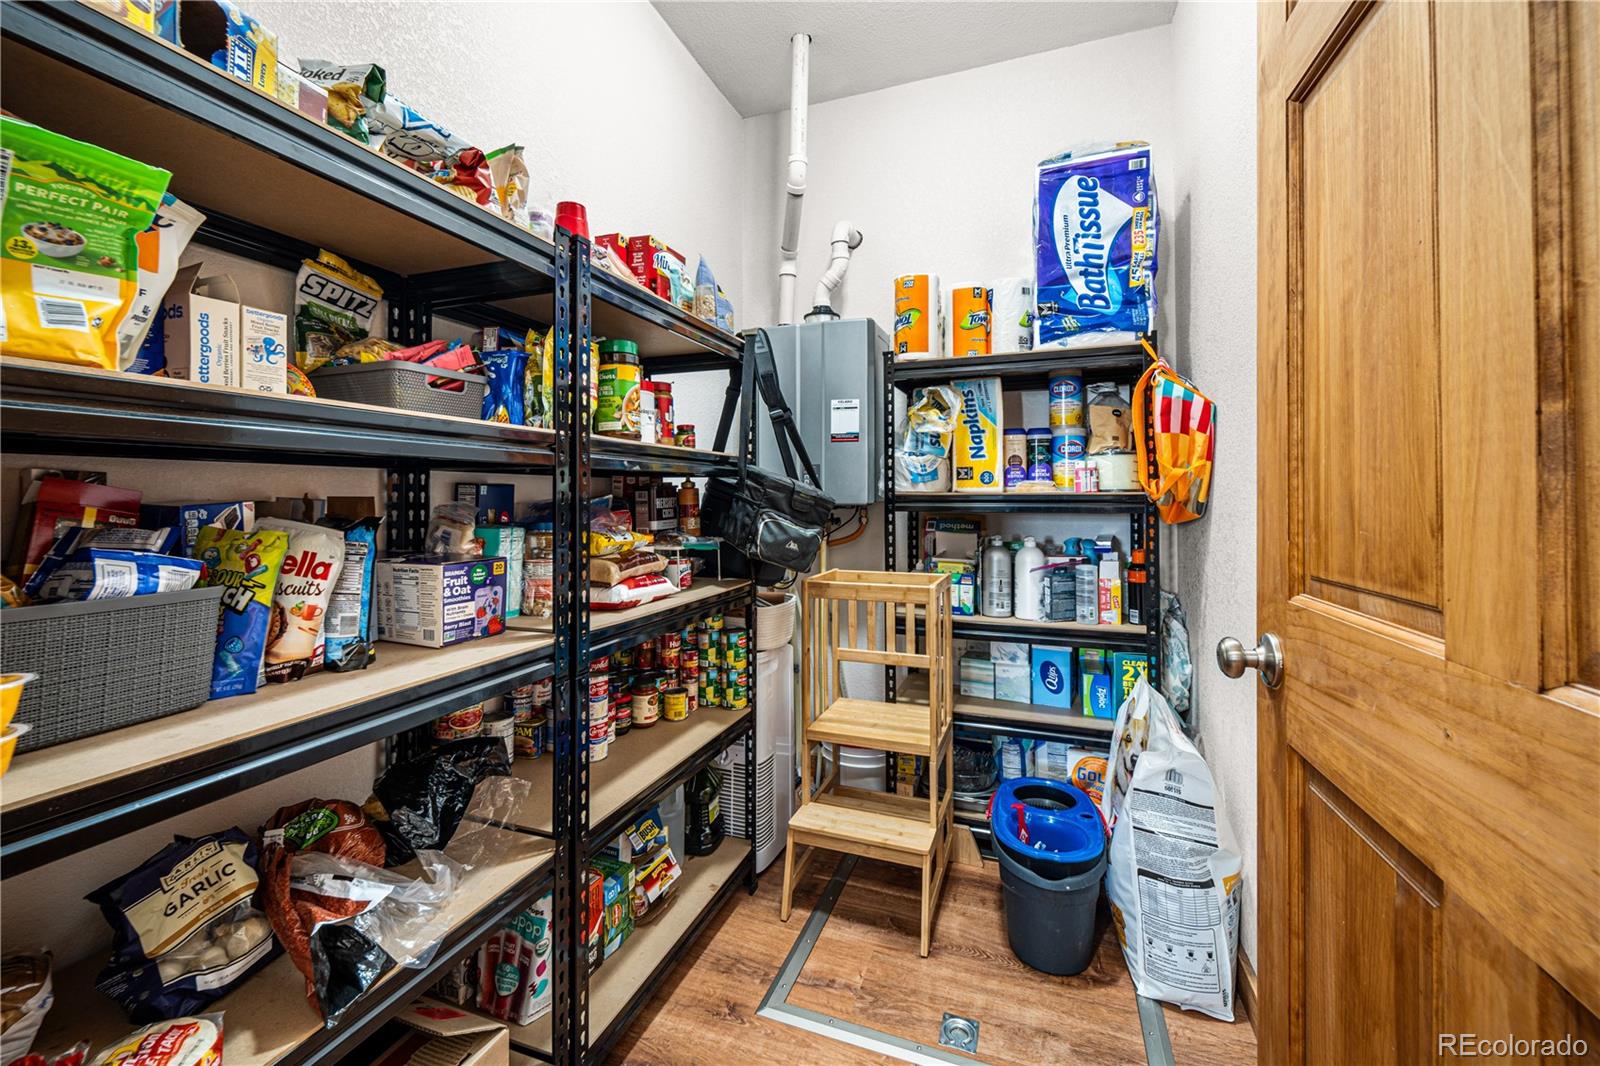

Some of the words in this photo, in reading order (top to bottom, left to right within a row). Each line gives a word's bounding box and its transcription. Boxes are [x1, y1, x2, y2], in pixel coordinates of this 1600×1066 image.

[15, 181, 89, 208] PERFECT
[92, 201, 129, 219] PAIR
[1063, 214, 1072, 252] Premium
[300, 273, 378, 319] SPITZ
[200, 312, 212, 384] ettergoods
[1053, 384, 1074, 393] CLOROX
[961, 389, 987, 459] Napkins
[1060, 445, 1082, 453] CLOROX
[939, 522, 975, 530] method
[443, 576, 469, 588] Fruit
[443, 587, 452, 597] &
[452, 585, 472, 596] Oat
[443, 623, 458, 631] Berry
[1122, 659, 1148, 667] CLEAN
[1096, 685, 1107, 709] Ziploc
[163, 862, 237, 918] GARLIC
